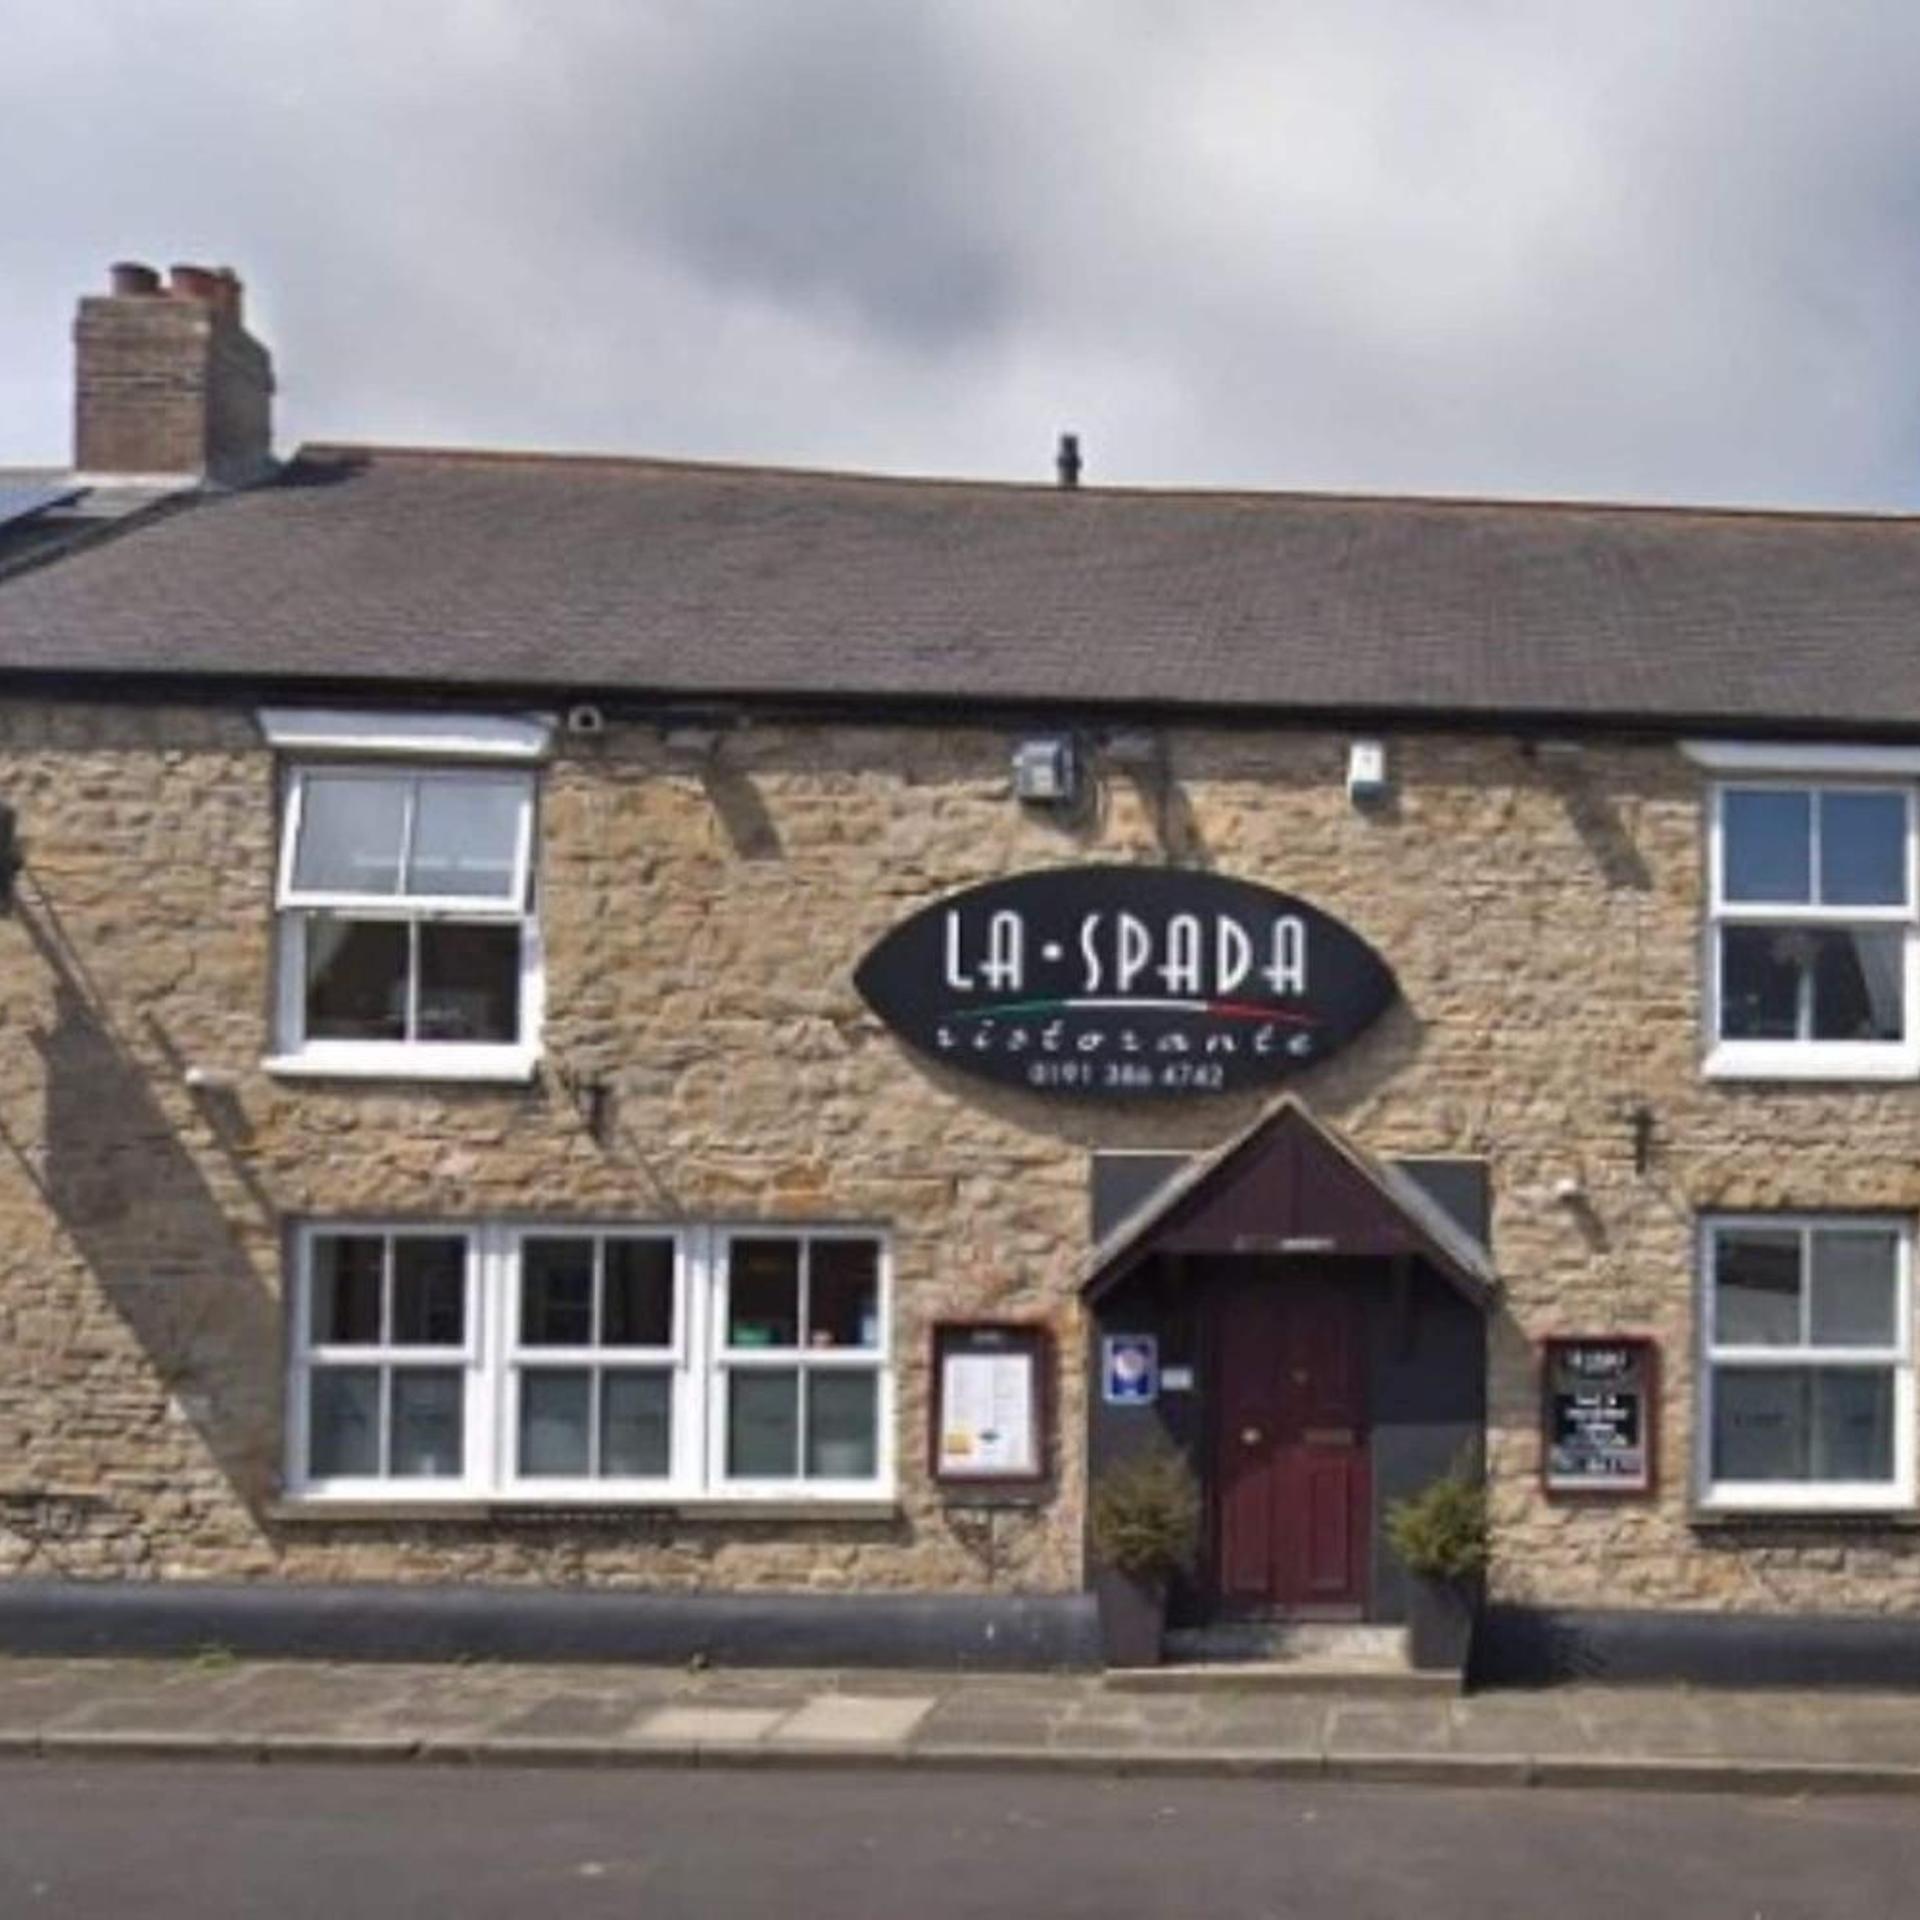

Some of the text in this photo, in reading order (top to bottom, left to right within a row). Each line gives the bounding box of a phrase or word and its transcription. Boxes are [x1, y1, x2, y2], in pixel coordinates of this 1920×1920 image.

[945, 910, 1305, 994] LA SPADA
[937, 1021, 1311, 1053] ristorante
[1029, 1063, 1091, 1087] 0191
